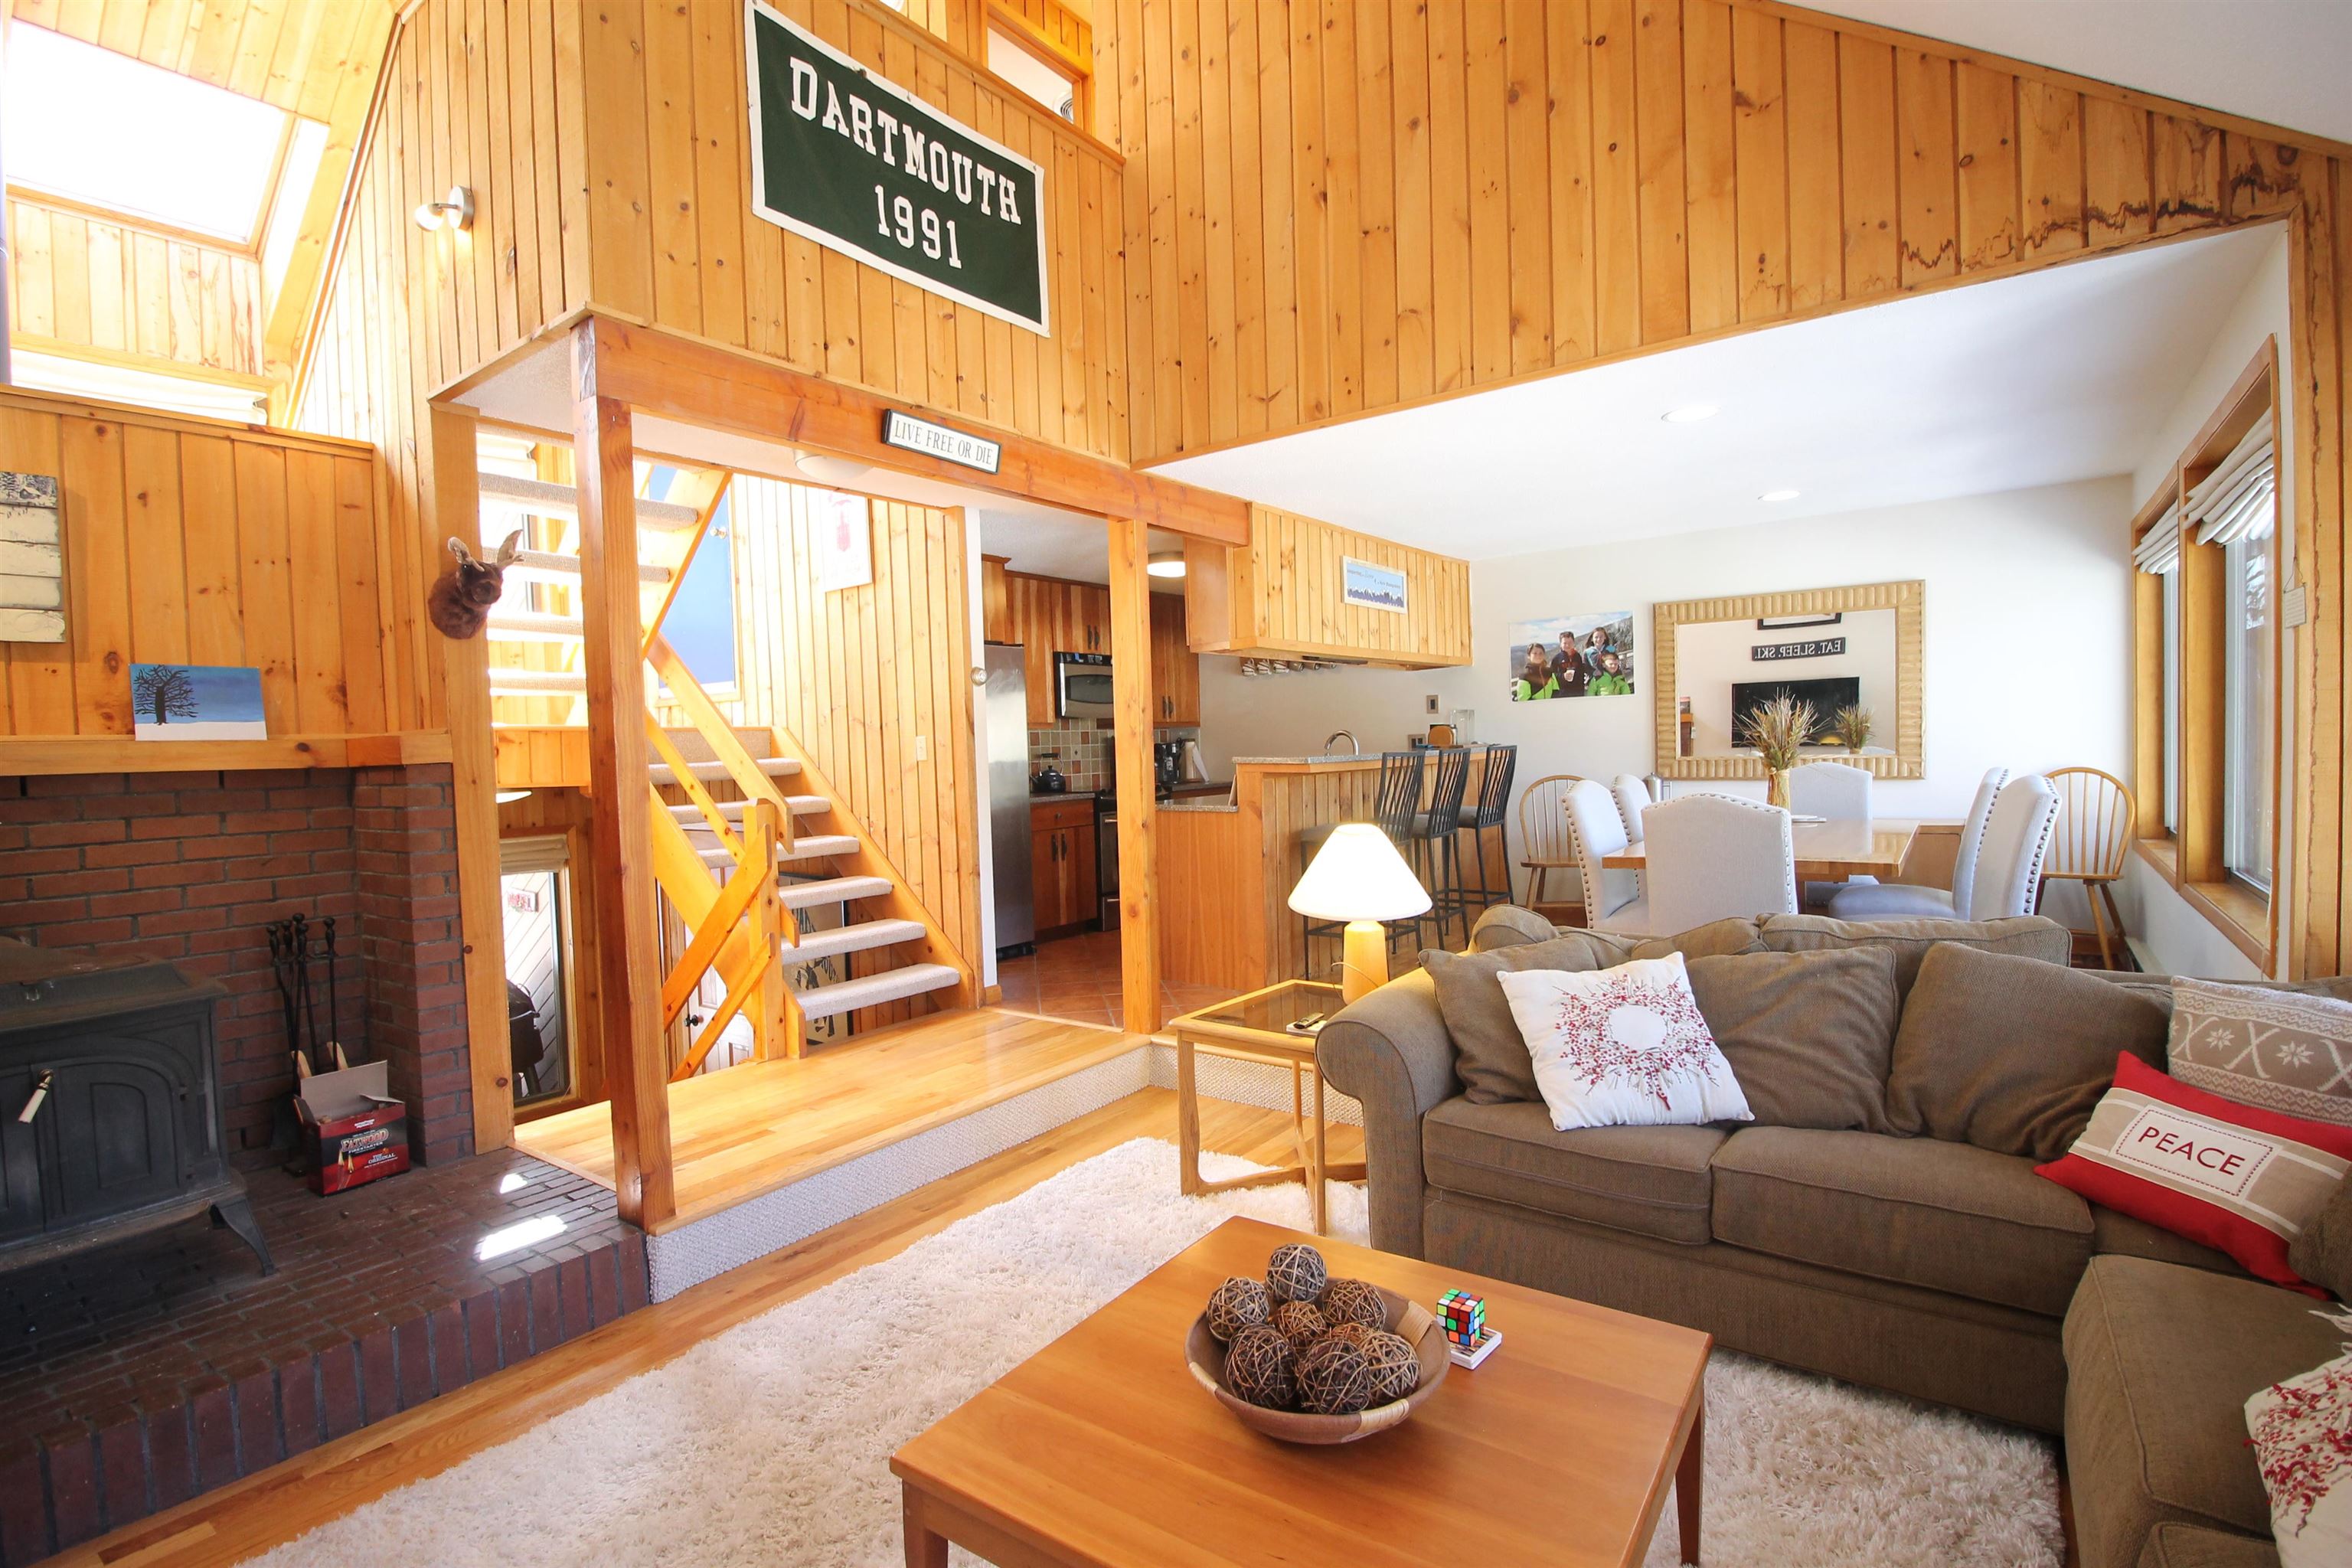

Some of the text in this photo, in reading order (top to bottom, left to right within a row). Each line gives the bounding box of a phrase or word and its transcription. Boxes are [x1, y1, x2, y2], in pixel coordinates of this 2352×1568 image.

[789, 56, 1021, 225] DARTMOUTH
[874, 185, 962, 270] 1991
[894, 420, 993, 465] LIVE FREE OR DIE
[341, 1129, 388, 1152] FATWOOD
[2138, 1126, 2246, 1176] PEACE
